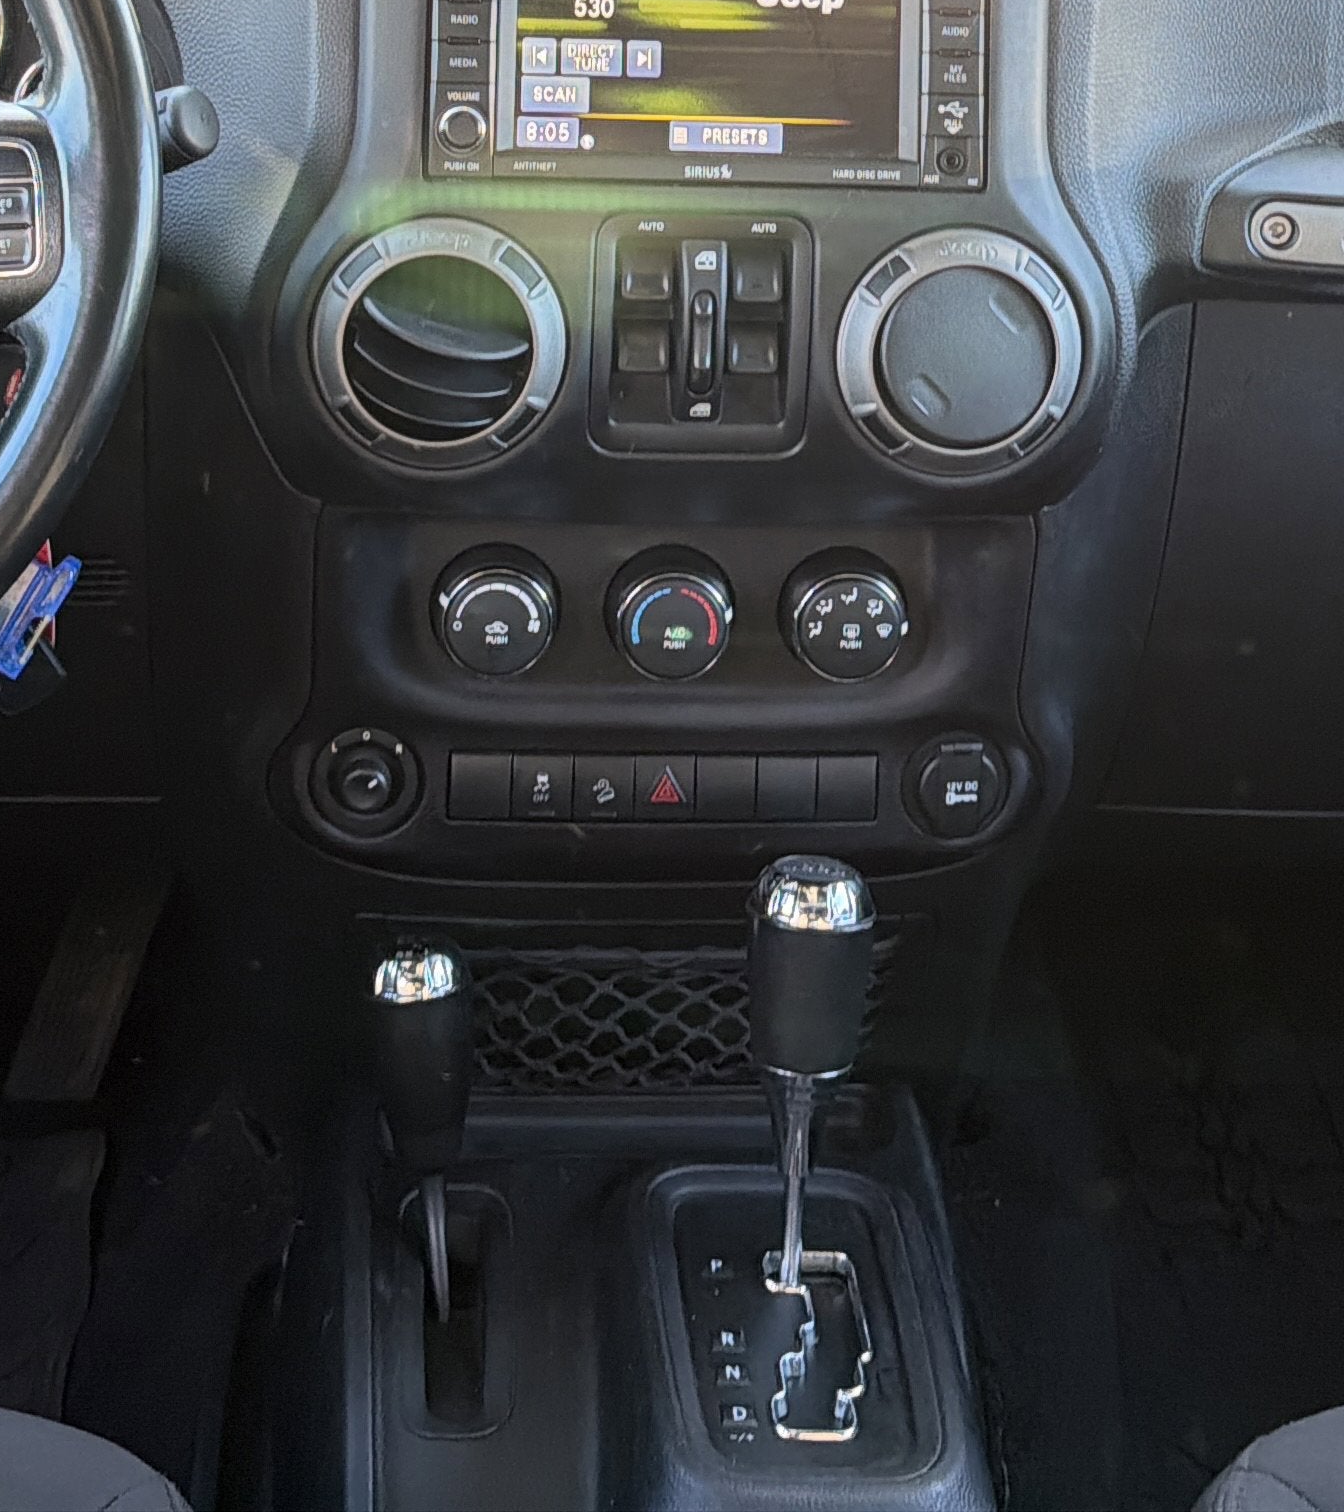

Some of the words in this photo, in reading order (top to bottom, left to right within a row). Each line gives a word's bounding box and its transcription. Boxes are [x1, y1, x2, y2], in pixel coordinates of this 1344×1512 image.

[451, 15, 478, 25] RADIO
[942, 26, 969, 37] AUDIO
[567, 44, 615, 57] DIRECT
[449, 57, 478, 68] MEDIA
[573, 57, 610, 71] TUNE
[447, 91, 480, 101] VOLUME
[533, 86, 576, 103] SCAN
[526, 122, 570, 142] 8:05
[703, 129, 768, 145] PRESETS
[513, 161, 557, 172] ANTITHEFT
[685, 166, 721, 178] SIRIUS
[638, 222, 665, 232] AUTO
[751, 223, 777, 233] AUTO
[485, 635, 508, 644] PUSH
[663, 640, 686, 649] PUSH
[840, 640, 862, 649] PUSH
[711, 1258, 722, 1272] P
[721, 1330, 735, 1347] R
[725, 1364, 741, 1380] N
[732, 1406, 747, 1421] D
